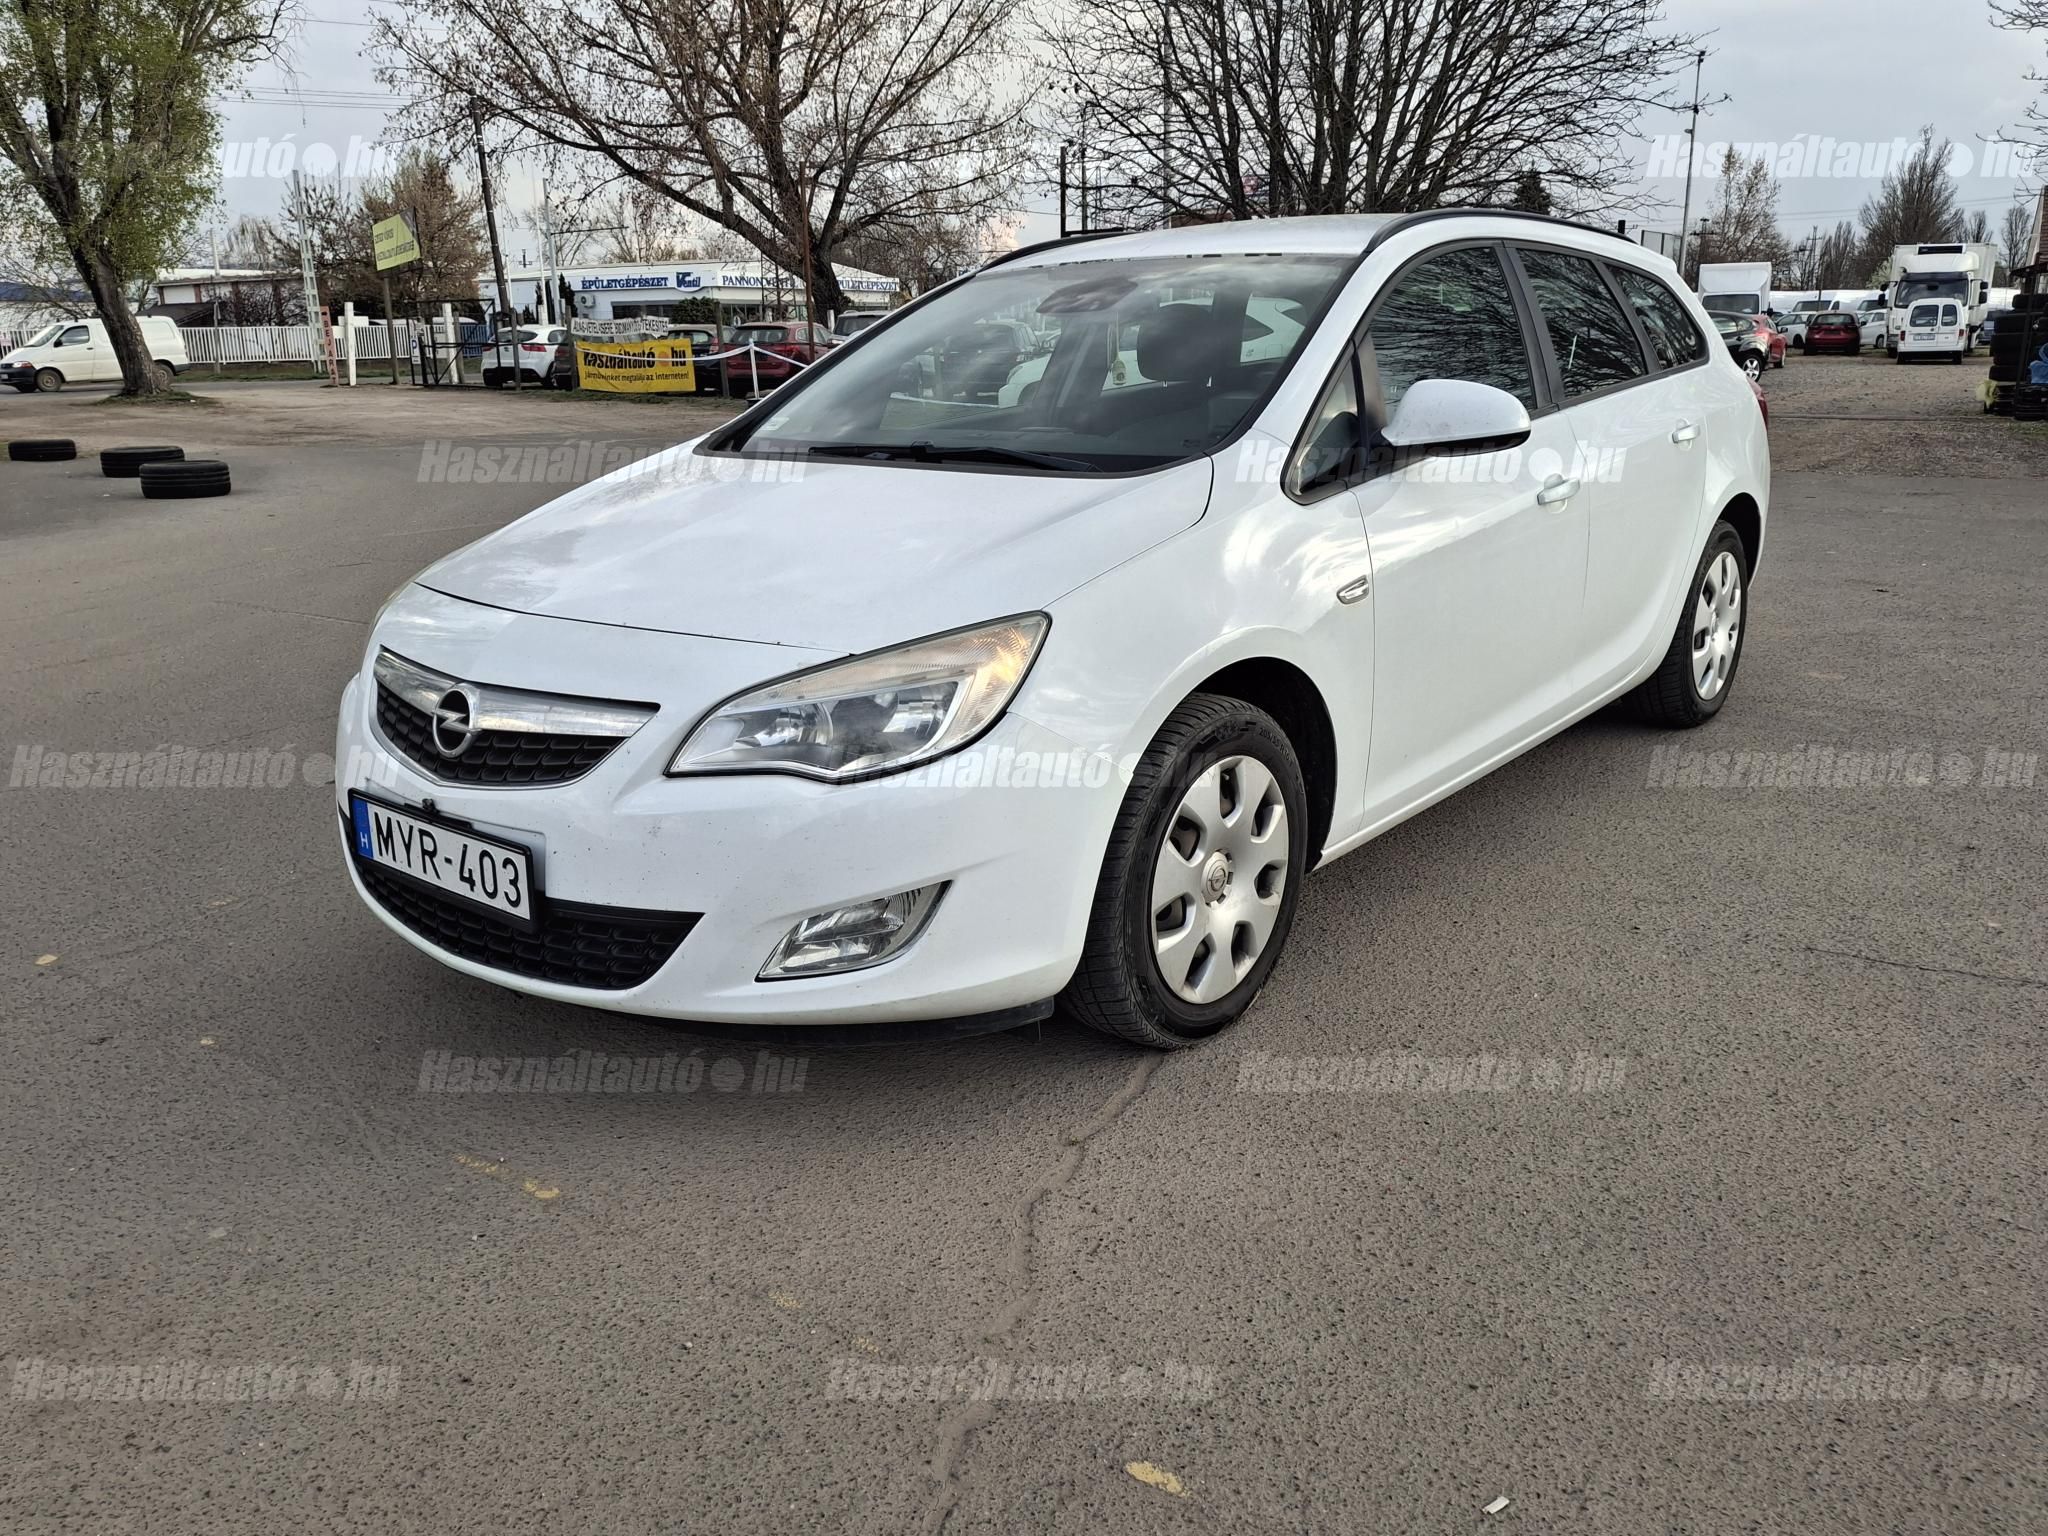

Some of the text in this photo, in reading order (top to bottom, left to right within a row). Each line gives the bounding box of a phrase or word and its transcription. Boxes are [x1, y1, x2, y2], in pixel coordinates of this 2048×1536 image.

[581, 275, 669, 290] ÉPÜLETGÉPÉSZET
[722, 275, 762, 287] PANNON
[836, 277, 897, 291] PÜLETGÉPÉSZET
[360, 831, 369, 849] H
[374, 811, 522, 908] MYR-403
